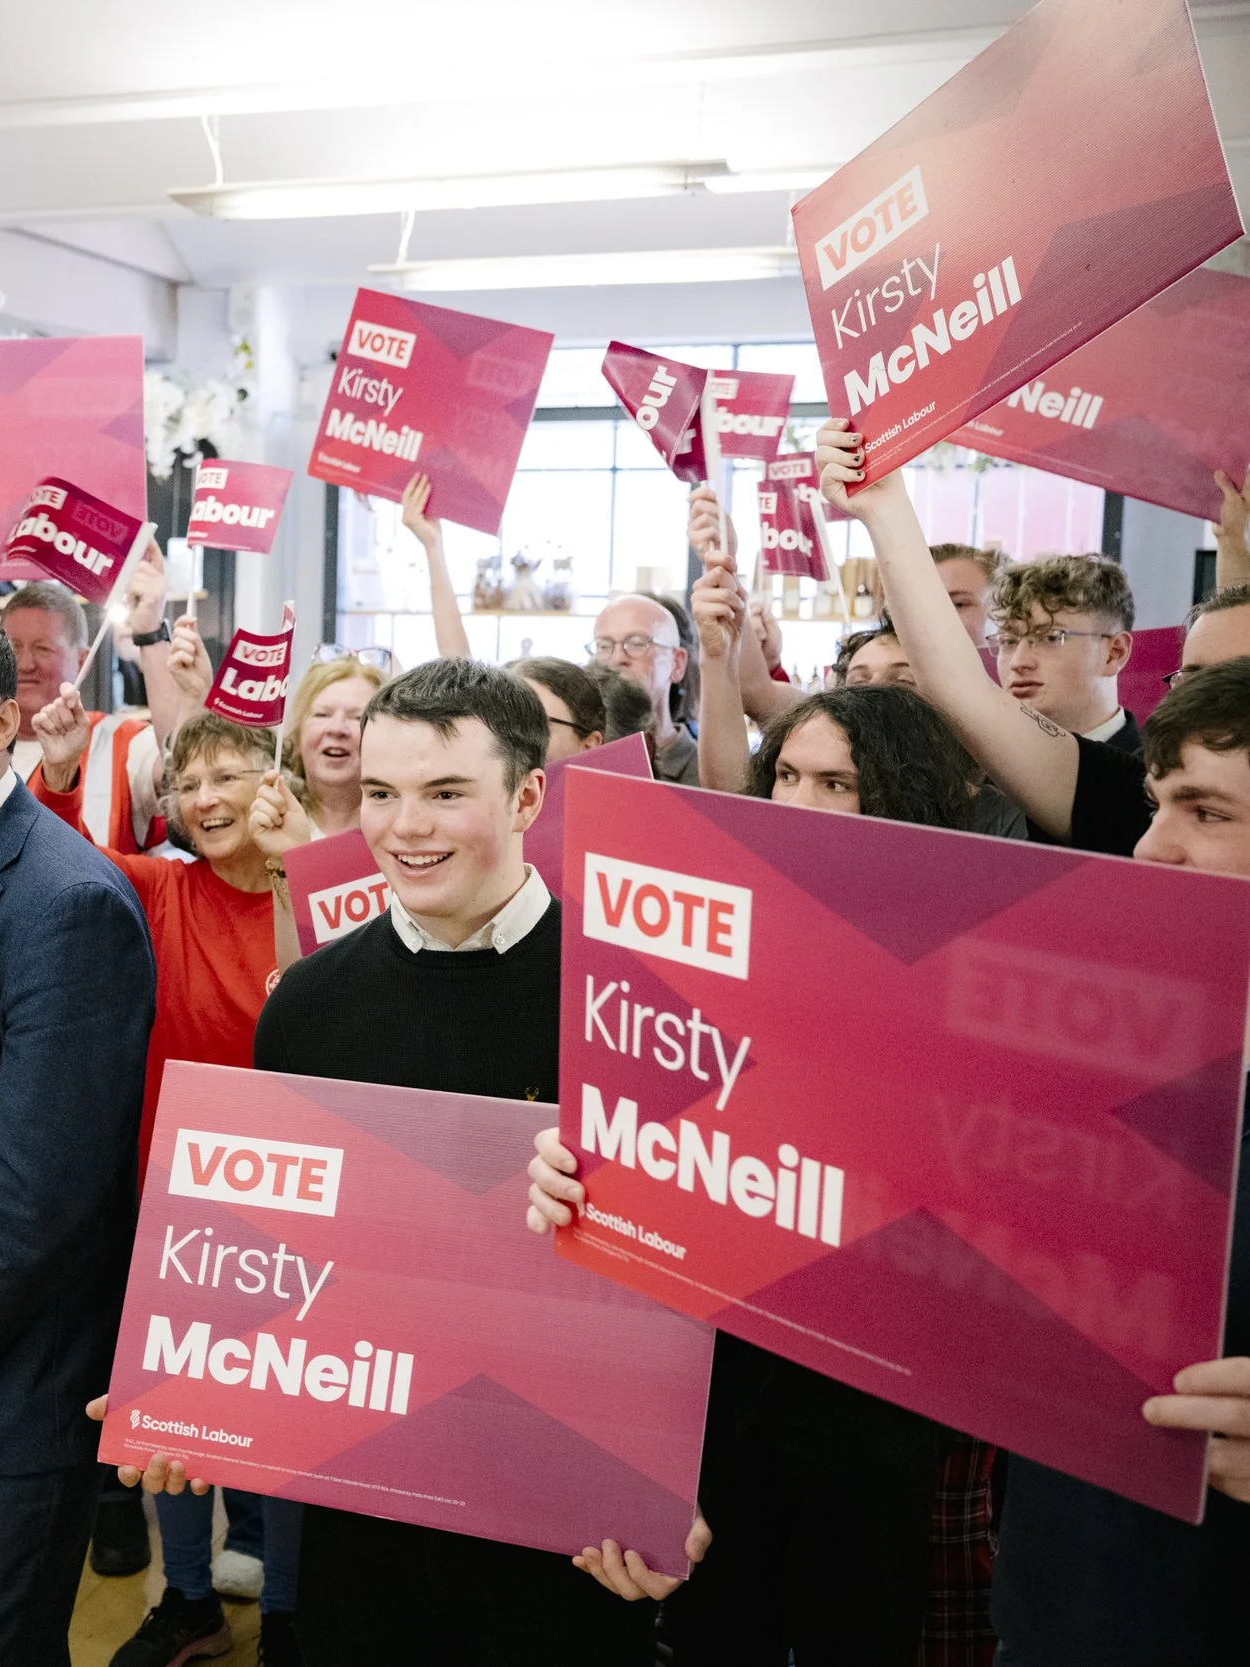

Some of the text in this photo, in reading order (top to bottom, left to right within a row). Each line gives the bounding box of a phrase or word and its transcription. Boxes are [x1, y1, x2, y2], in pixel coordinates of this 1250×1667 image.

[822, 180, 918, 272] VOTE
[831, 242, 940, 350] Kirsty
[357, 328, 410, 361] VOTE
[843, 255, 1022, 416] McNeill
[337, 366, 404, 416] Kirsty
[636, 364, 678, 430] our
[1007, 380, 1103, 430] Neill
[325, 408, 424, 462] McNeill
[716, 405, 786, 437] bour
[864, 423, 902, 454] Scottish
[902, 401, 937, 430] Labour
[770, 463, 807, 476] VOTE
[190, 495, 275, 529] abour
[241, 647, 284, 663] VOTE
[317, 881, 389, 930] VOT
[596, 870, 735, 958] VOTE
[584, 974, 751, 1112] Kirsty
[187, 1141, 328, 1203] VOTE
[581, 1082, 845, 1248] McNeill
[585, 1202, 637, 1240] Scottish
[637, 1224, 687, 1261] Labour
[158, 1225, 334, 1321] Kirsty
[142, 1314, 414, 1415] McNeill
[141, 1414, 254, 1448] Scottish Labour
